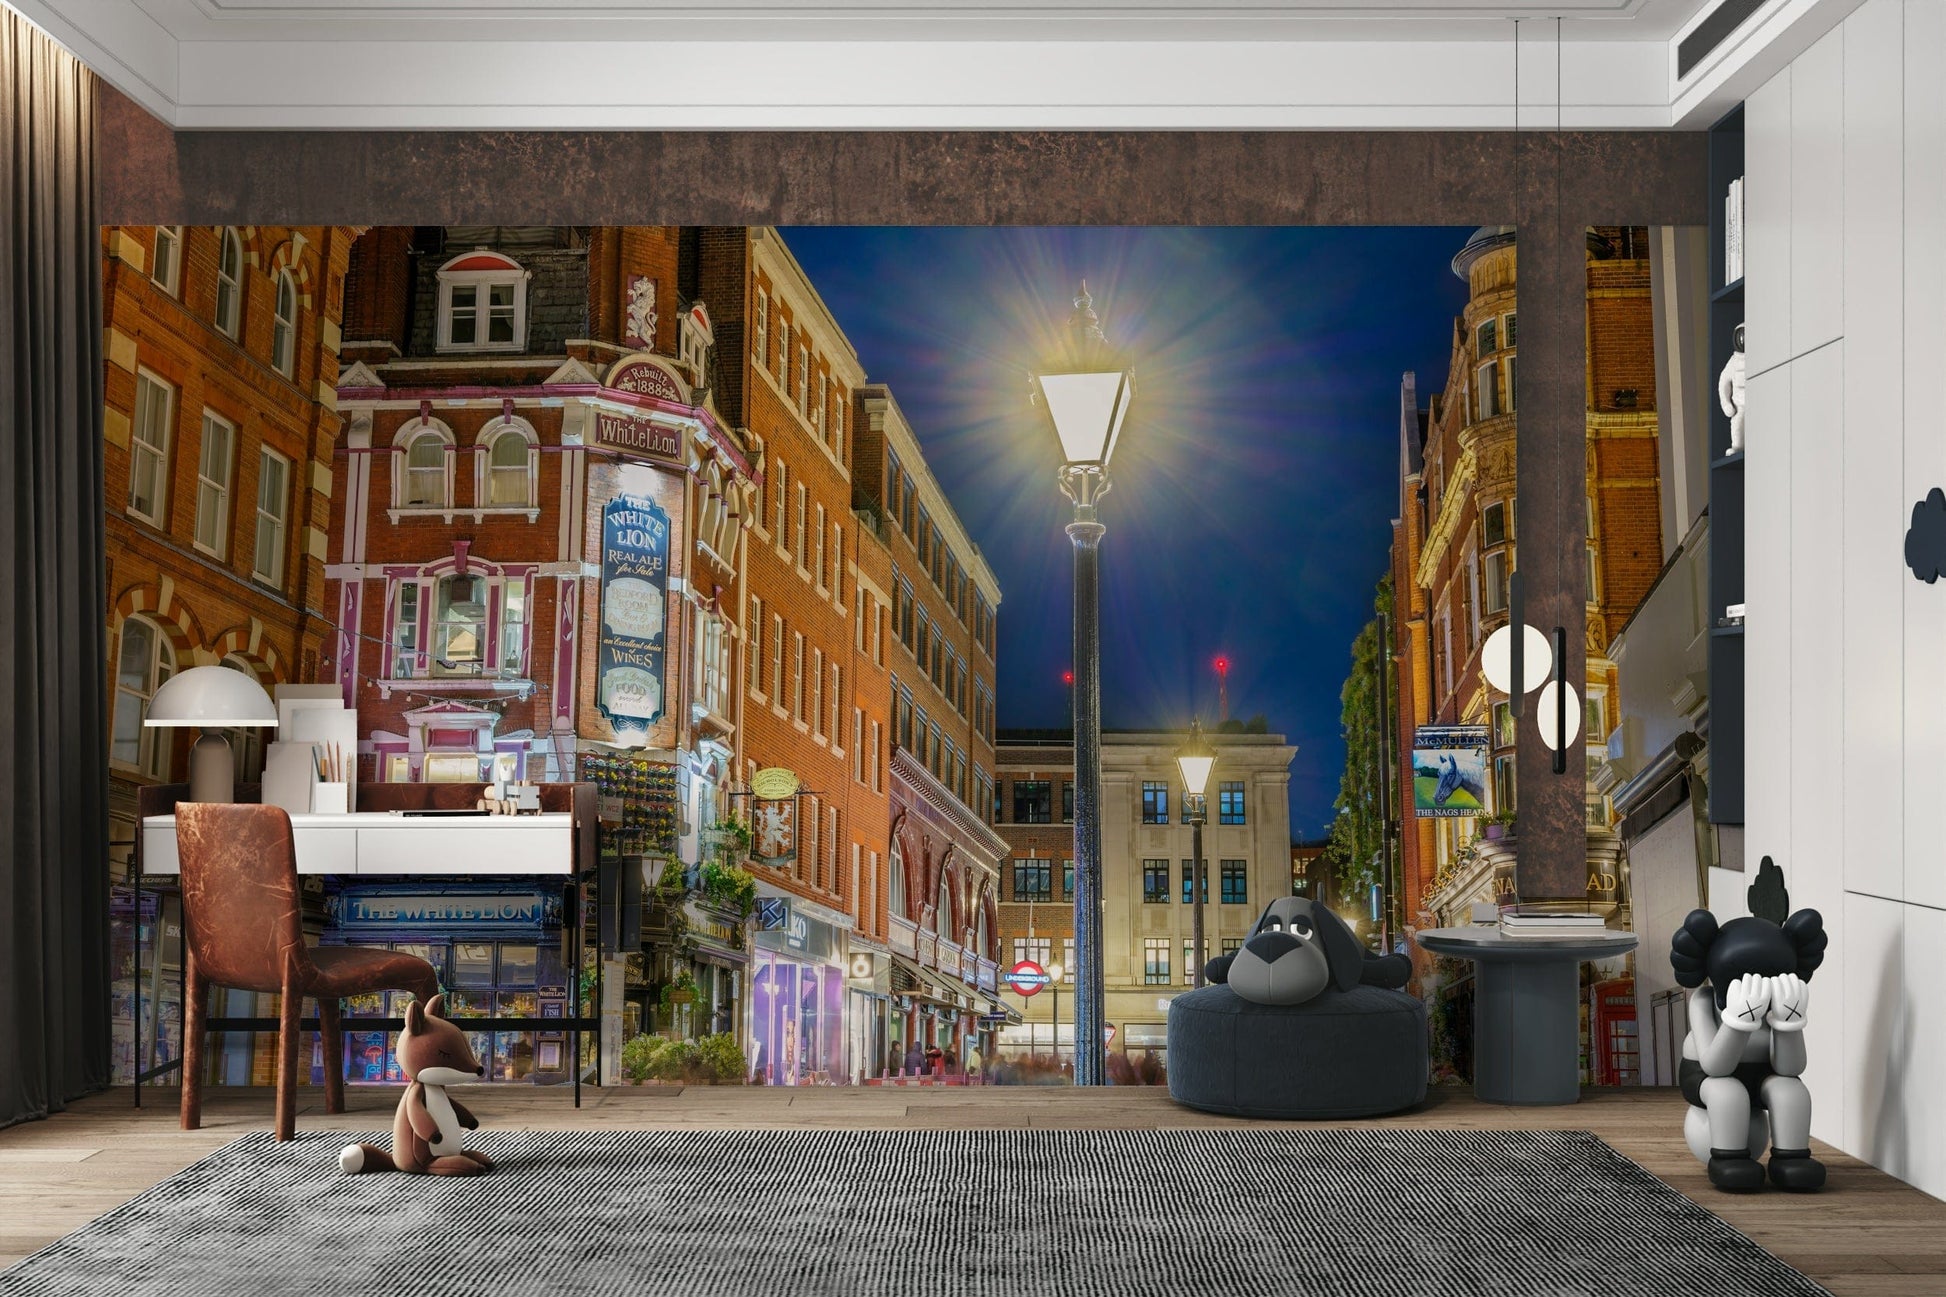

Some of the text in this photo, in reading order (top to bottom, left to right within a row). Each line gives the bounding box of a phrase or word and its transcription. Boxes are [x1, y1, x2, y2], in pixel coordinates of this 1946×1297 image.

[631, 367, 668, 386] Rebuilt
[637, 380, 662, 396] 1888
[625, 496, 651, 511] THE
[607, 511, 665, 538] WHITE
[617, 529, 656, 552] LION
[608, 549, 663, 571] REAL ALE
[632, 564, 655, 576] Sale
[613, 635, 643, 649] Excellent
[643, 642, 662, 653] choice
[611, 647, 653, 669] WINES
[616, 683, 647, 697] FOOD
[1417, 736, 1490, 746] McMULLEN
[1416, 808, 1486, 817] THE NAGS HEAD
[353, 902, 535, 920] THE WHITE LION
[1005, 974, 1050, 983] UNDERGROUND
[544, 1008, 559, 1016] FISH
